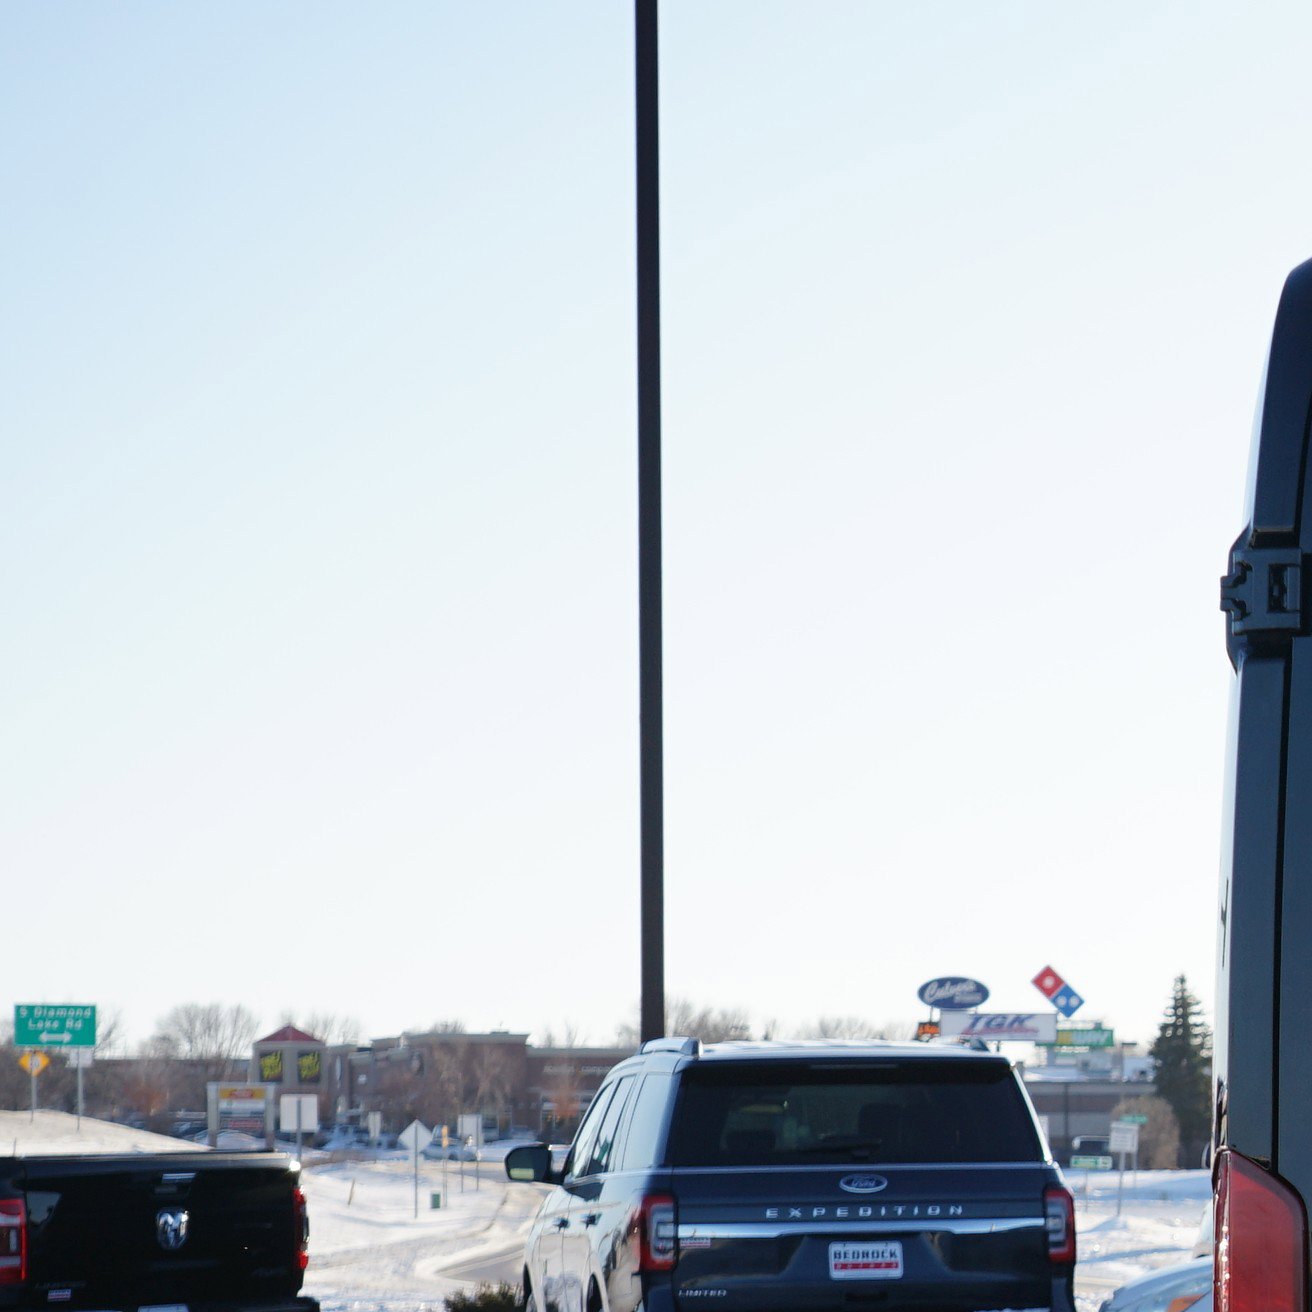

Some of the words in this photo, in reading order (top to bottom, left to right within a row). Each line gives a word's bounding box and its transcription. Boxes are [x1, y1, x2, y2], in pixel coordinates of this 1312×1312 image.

[34, 1006, 92, 1018] Diamond
[28, 1018, 60, 1031] Lake
[765, 1205, 963, 1219] EXPEDITION
[833, 1248, 898, 1260] BEDROCK
